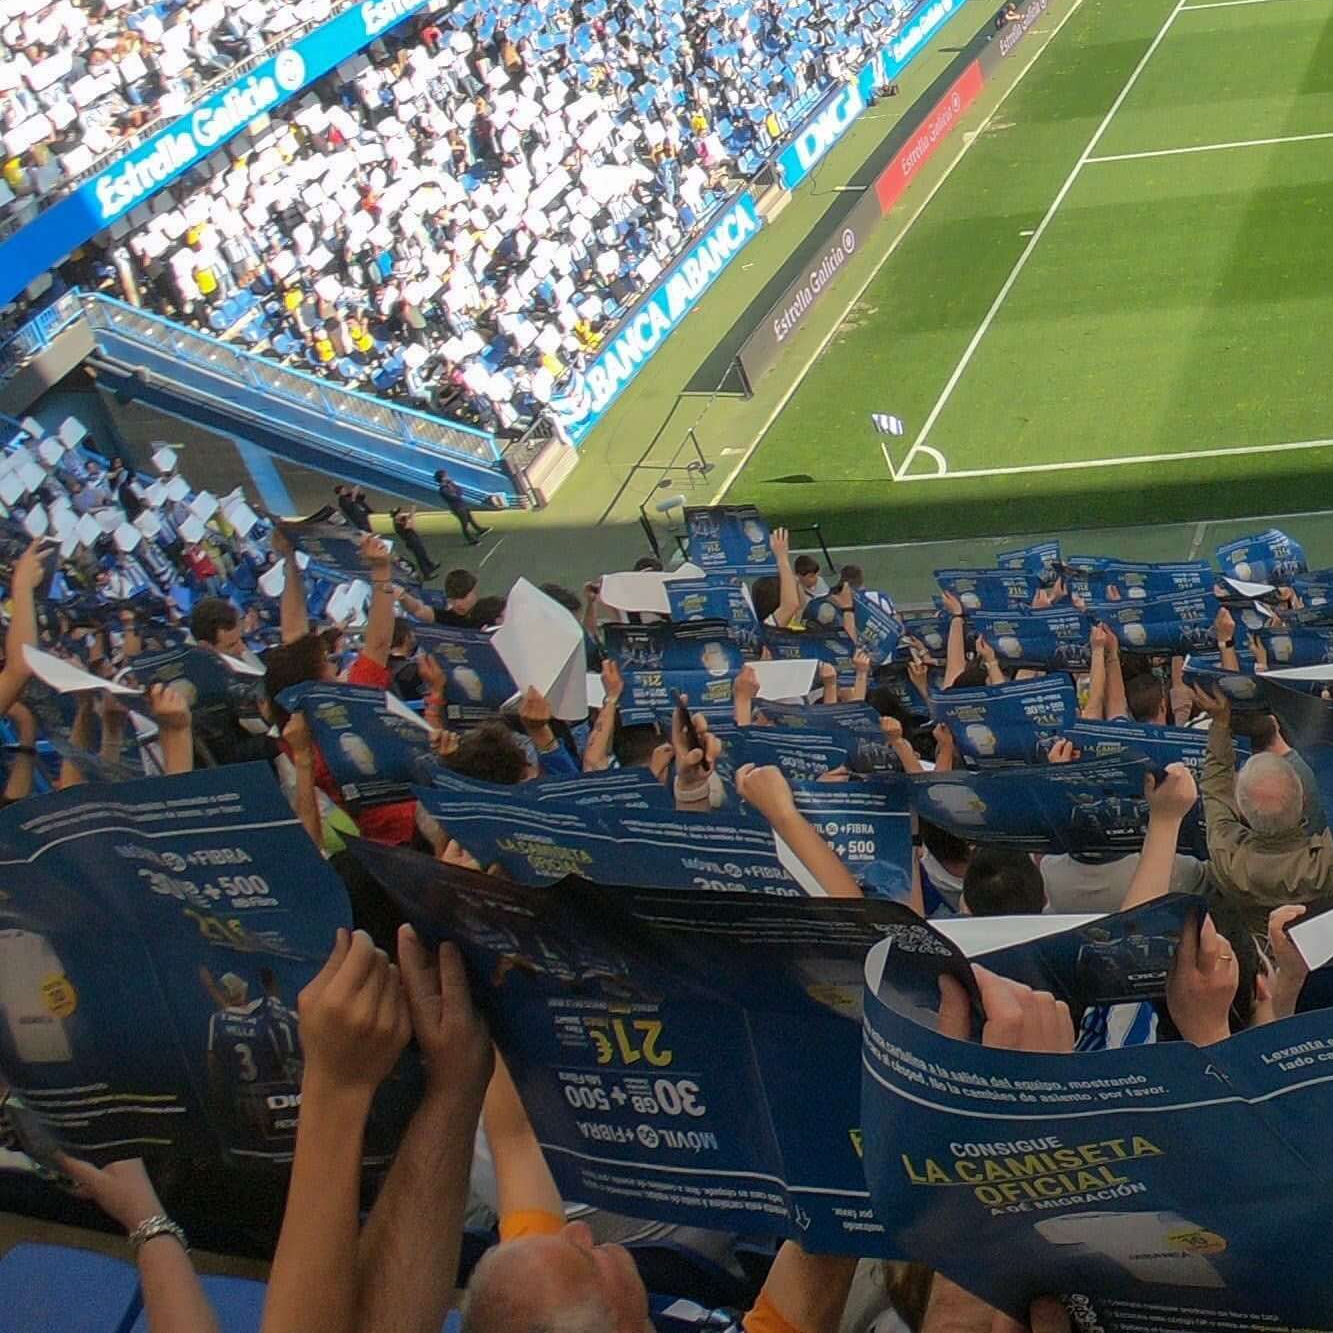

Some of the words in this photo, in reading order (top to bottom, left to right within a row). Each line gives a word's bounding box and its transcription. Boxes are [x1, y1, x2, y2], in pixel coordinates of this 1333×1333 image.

[795, 84, 865, 170] DIGI
[668, 205, 755, 314] ABANCA
[774, 291, 812, 342] Estrella
[810, 248, 844, 295] Galicia
[848, 841, 875, 853] 500
[218, 875, 270, 896] 500
[1261, 1039, 1324, 1065] Levanta
[1279, 1056, 1314, 1072] lado
[1069, 1074, 1147, 1090] mostrando
[1101, 1090, 1122, 1103] por
[1127, 1083, 1170, 1098] favor.
[565, 1086, 610, 1111] 500
[632, 1096, 659, 1114] GB
[654, 1079, 706, 1116] 30
[659, 1129, 718, 1154] MÓVIL
[950, 1136, 1062, 1158] CONSIGUE
[902, 1154, 951, 1183] LA
[955, 1136, 1161, 1182] CAMISETA
[974, 1166, 1128, 1206] OFICIAL
[1037, 1182, 1148, 1211] MIGRACIÓN
